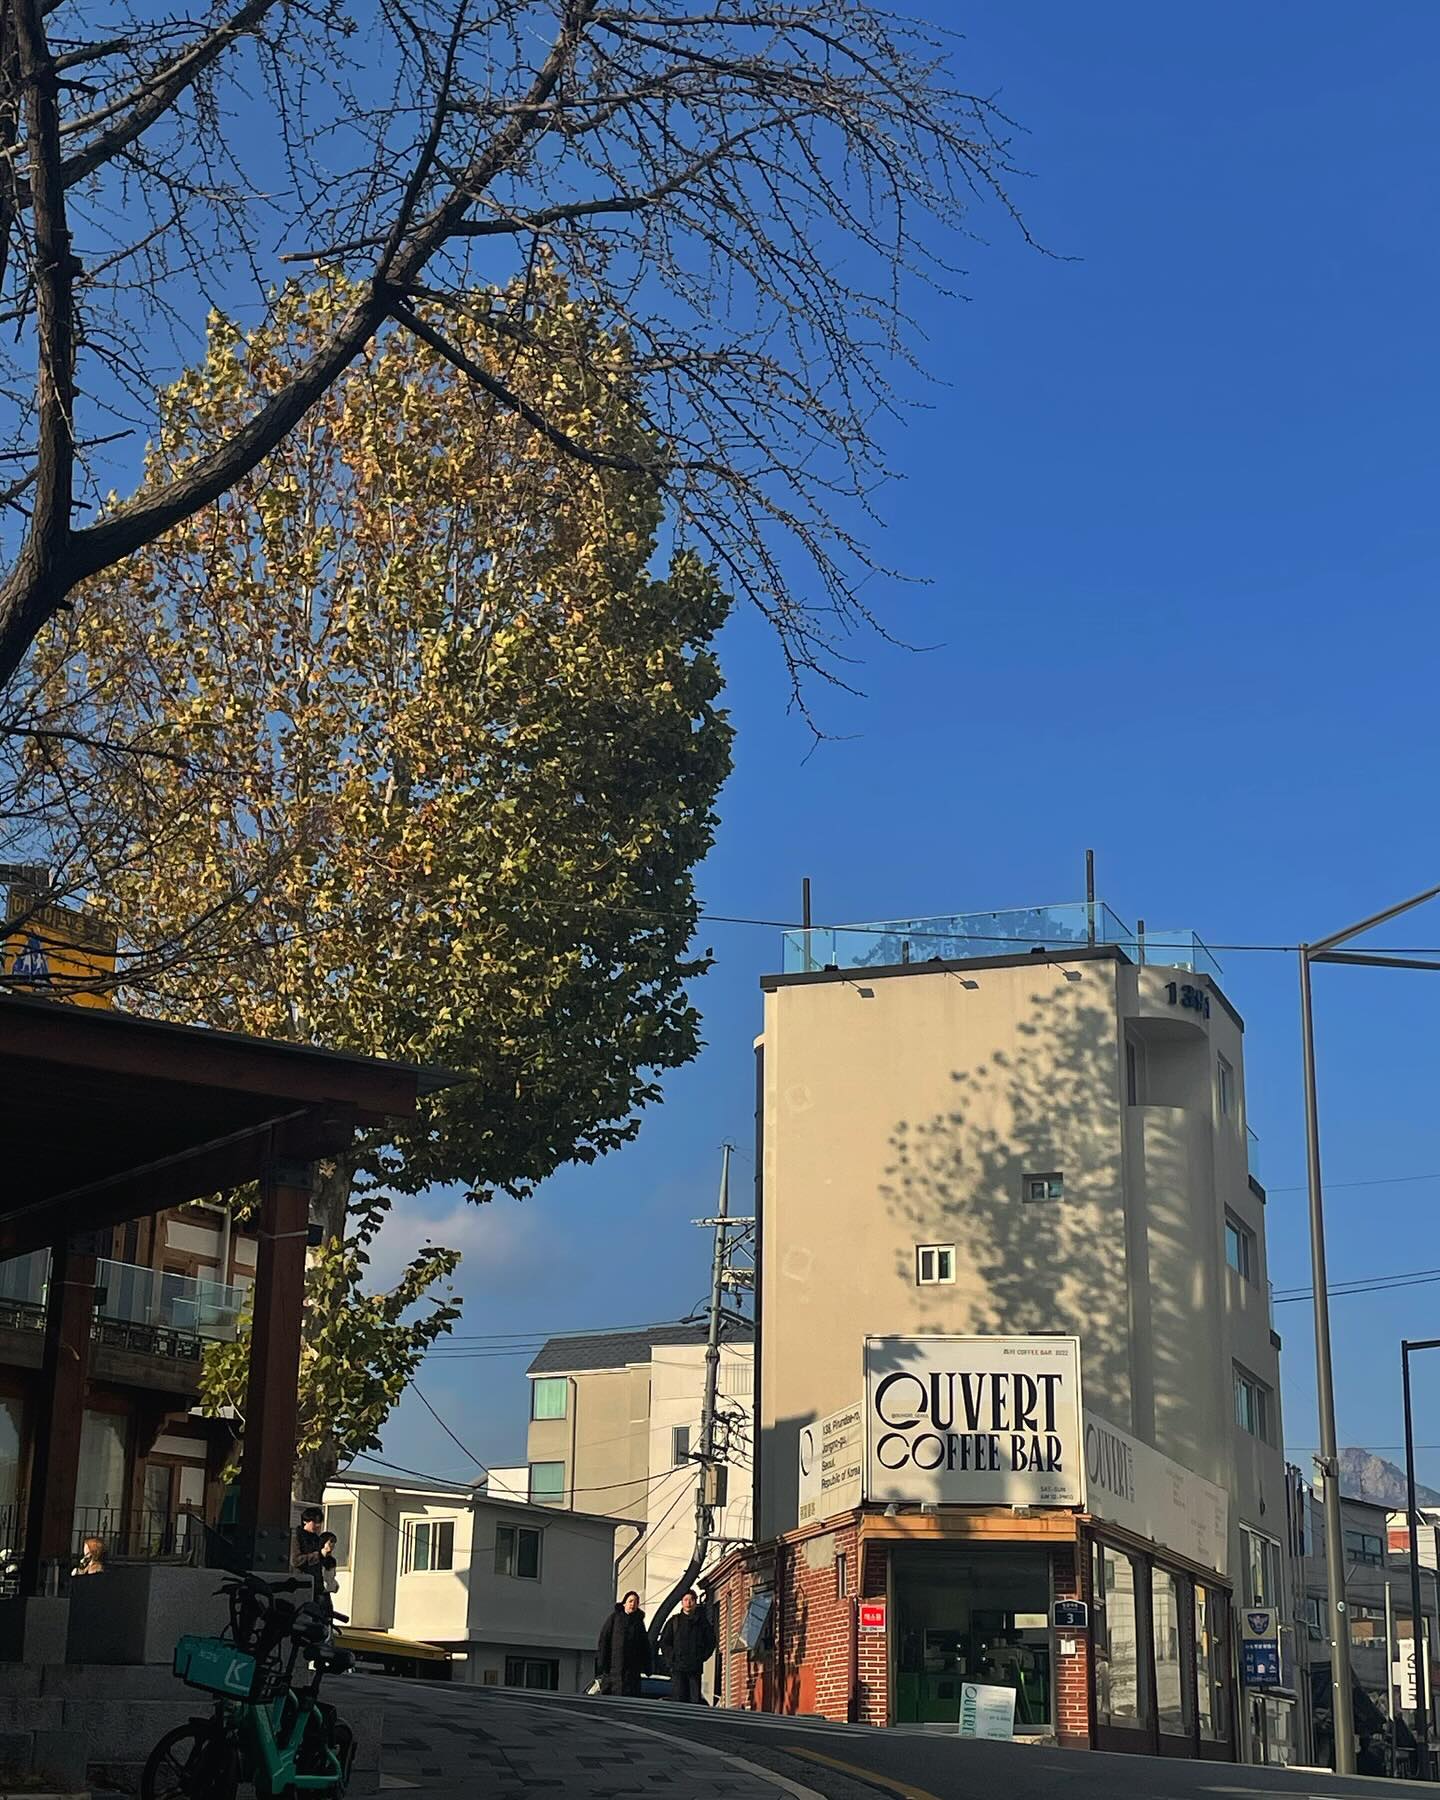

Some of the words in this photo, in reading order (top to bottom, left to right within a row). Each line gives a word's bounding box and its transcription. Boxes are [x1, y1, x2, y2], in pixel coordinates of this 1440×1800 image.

[875, 1371, 1063, 1432] OUVERT
[876, 1432, 1001, 1471] COFFEE
[1010, 1434, 1063, 1473] BAR
